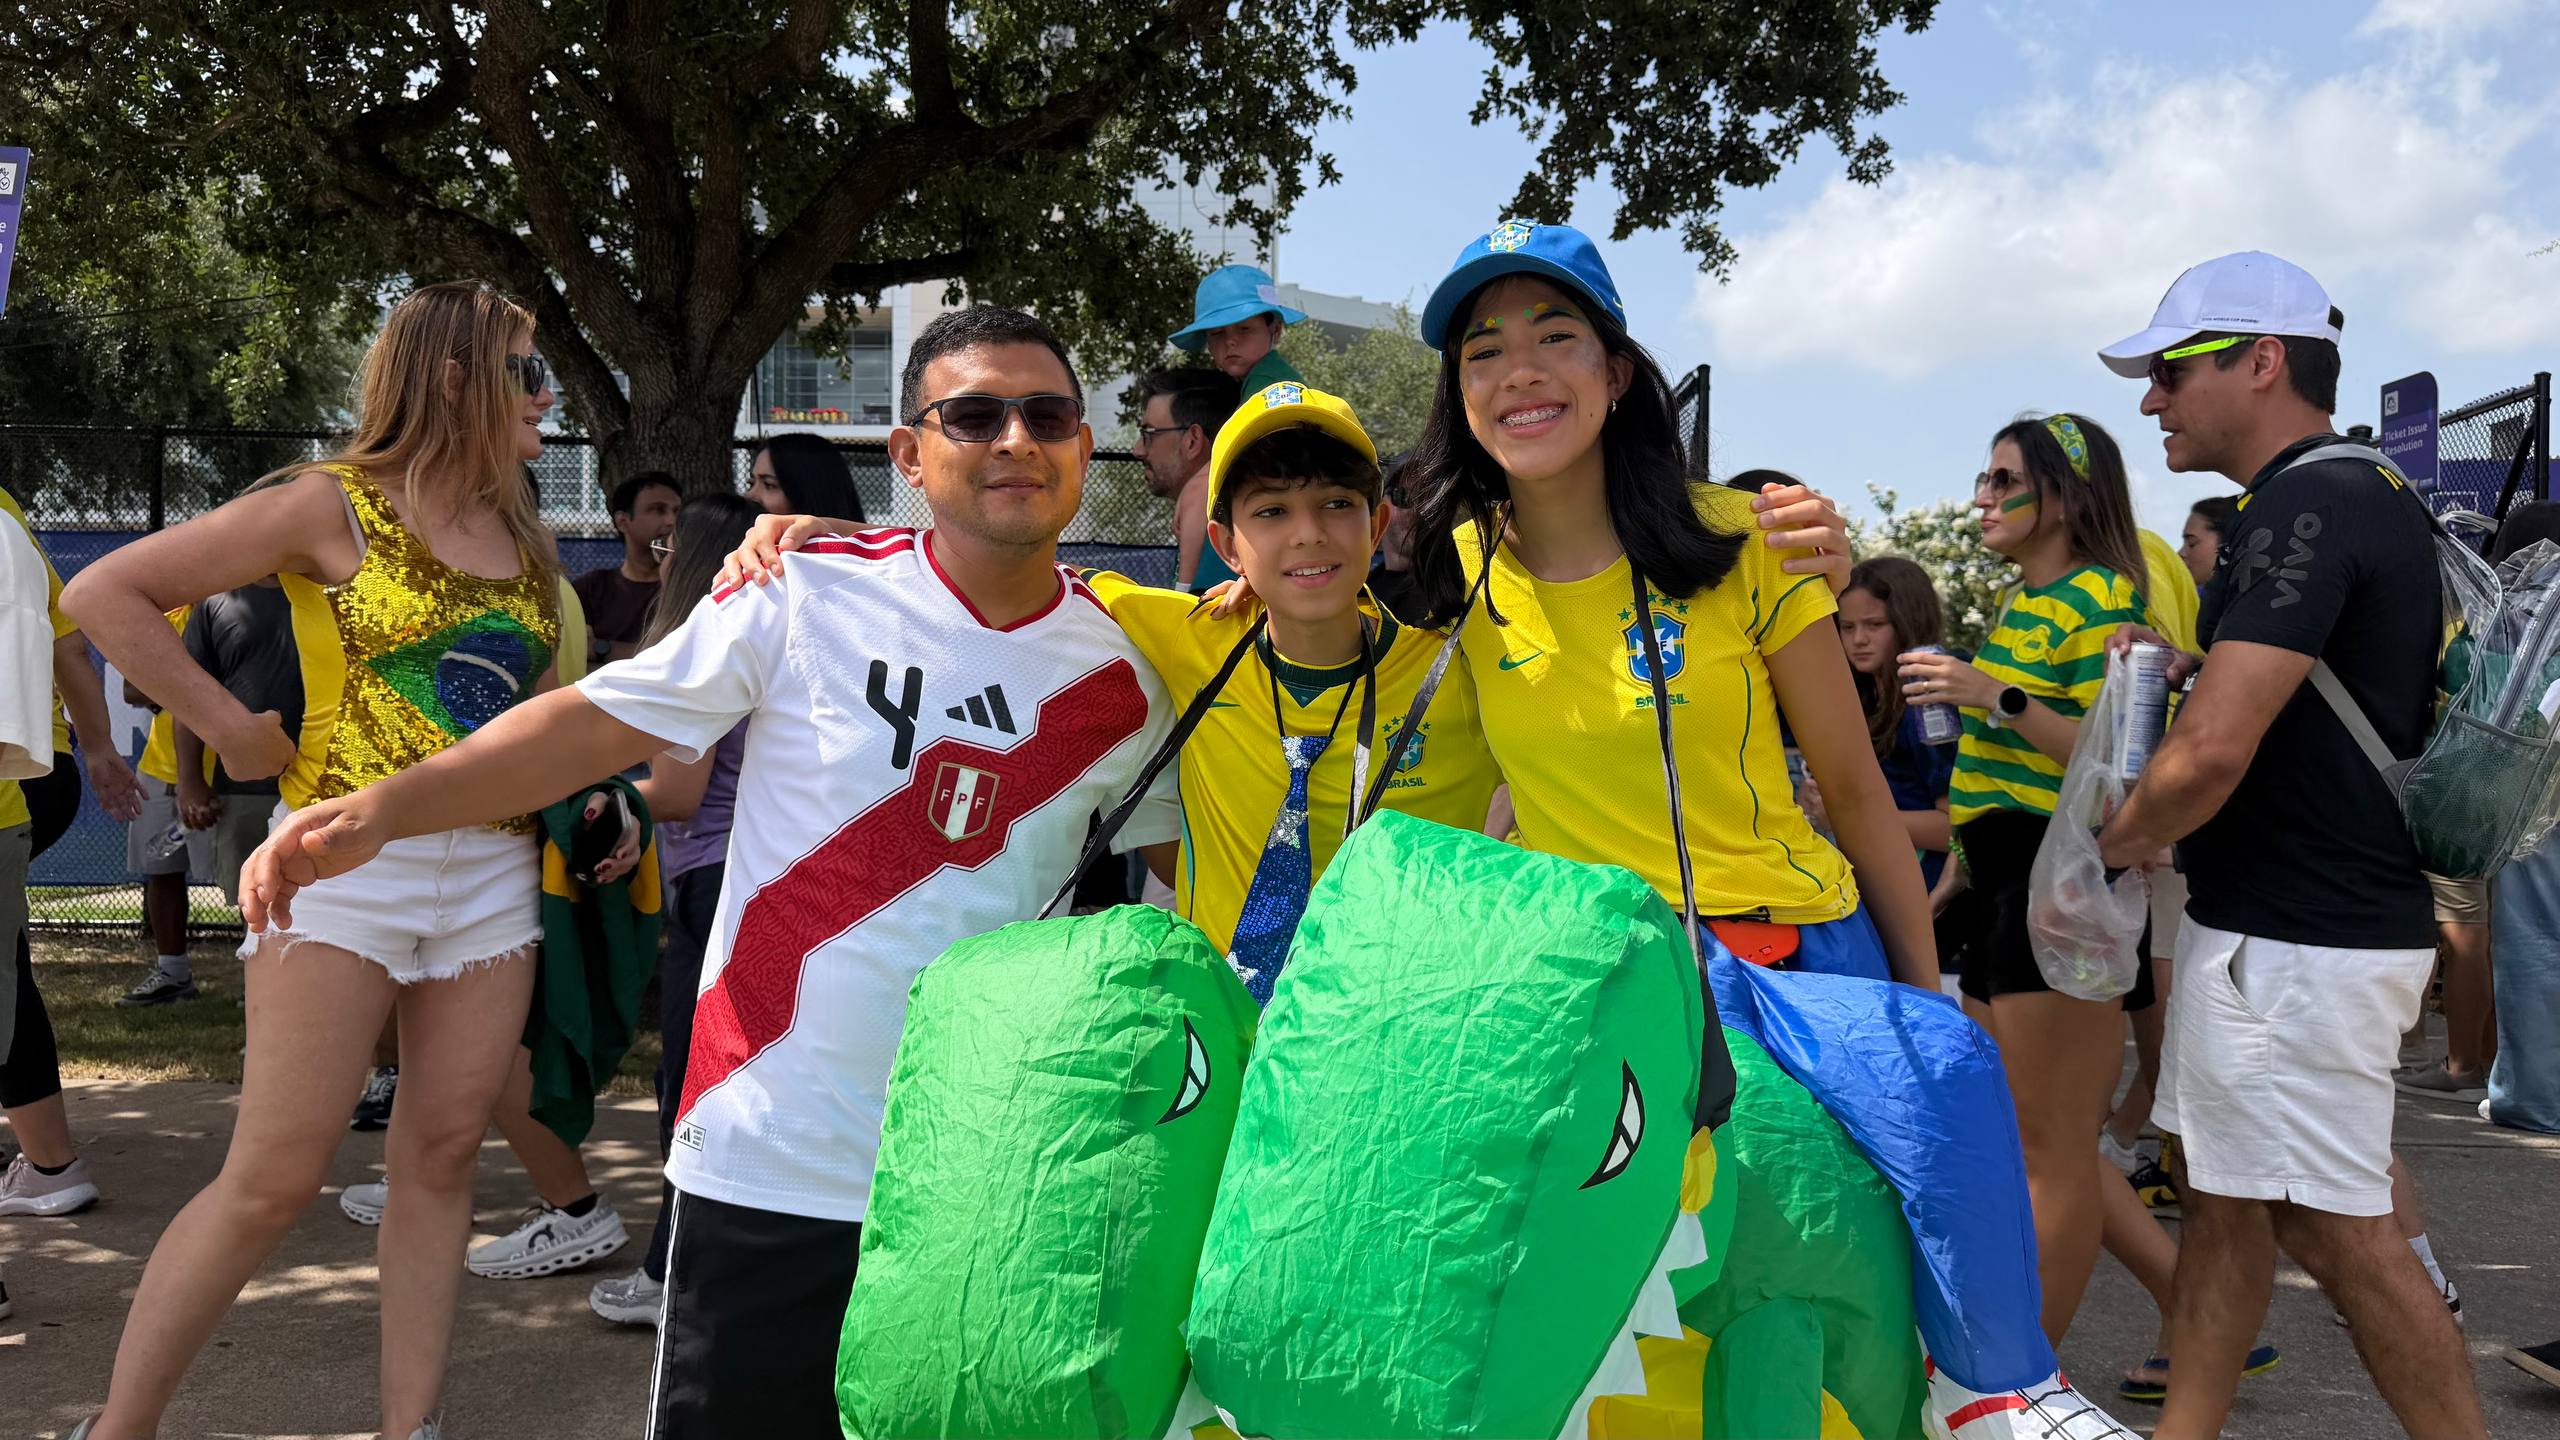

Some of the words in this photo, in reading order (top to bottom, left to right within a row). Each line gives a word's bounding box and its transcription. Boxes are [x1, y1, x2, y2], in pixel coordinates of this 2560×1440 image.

[2384, 428, 2407, 442] Ticket
[2407, 423, 2428, 436] Issue
[2384, 439, 2424, 456] Resolution
[2267, 512, 2322, 609] vivo
[1635, 693, 1690, 708] BRSIL
[940, 788, 986, 810] FPF
